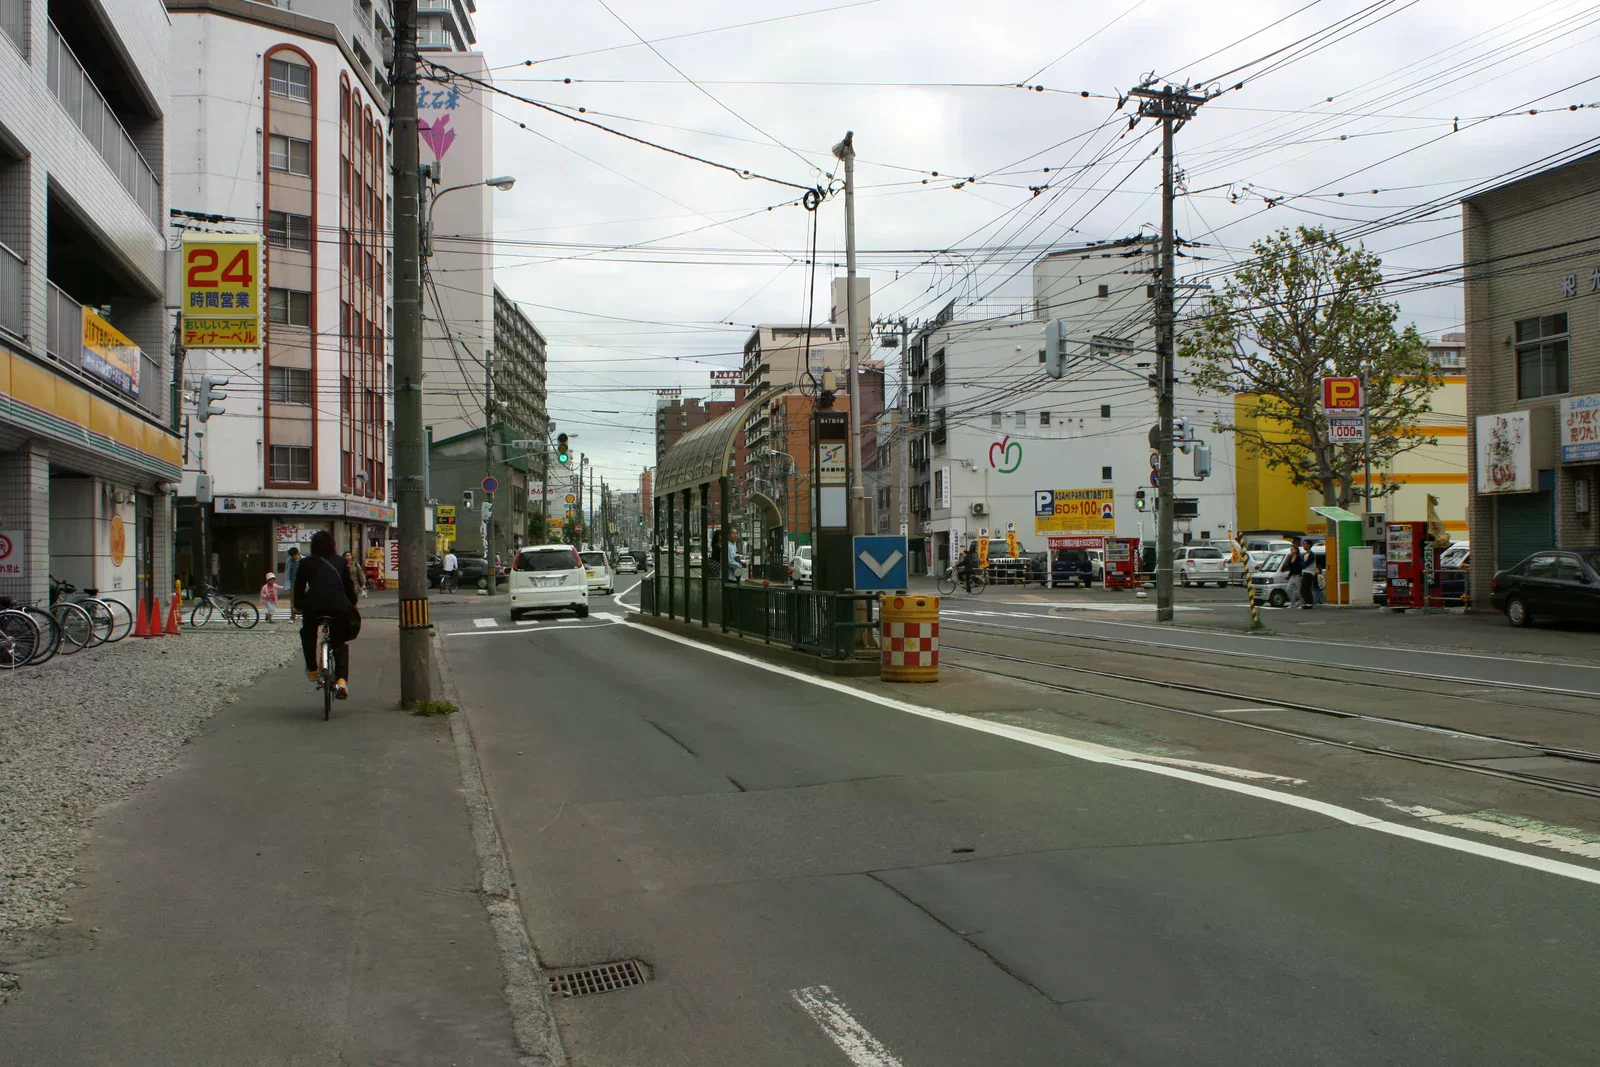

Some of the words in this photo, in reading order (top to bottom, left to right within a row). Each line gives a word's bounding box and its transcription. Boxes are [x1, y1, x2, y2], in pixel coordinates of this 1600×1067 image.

[188, 249, 252, 287] 24
[190, 292, 249, 308] 時間営業
[185, 321, 255, 330] おいしいスーパー
[186, 331, 255, 343] ディナーベル
[1331, 381, 1355, 407] P
[1330, 426, 1363, 438] 1,000円
[1036, 491, 1053, 512] P
[1055, 491, 1070, 500] ASAHI
[291, 501, 319, 511] チング
[390, 541, 398, 571] KIRIN
[980, 539, 988, 566] OPEN
